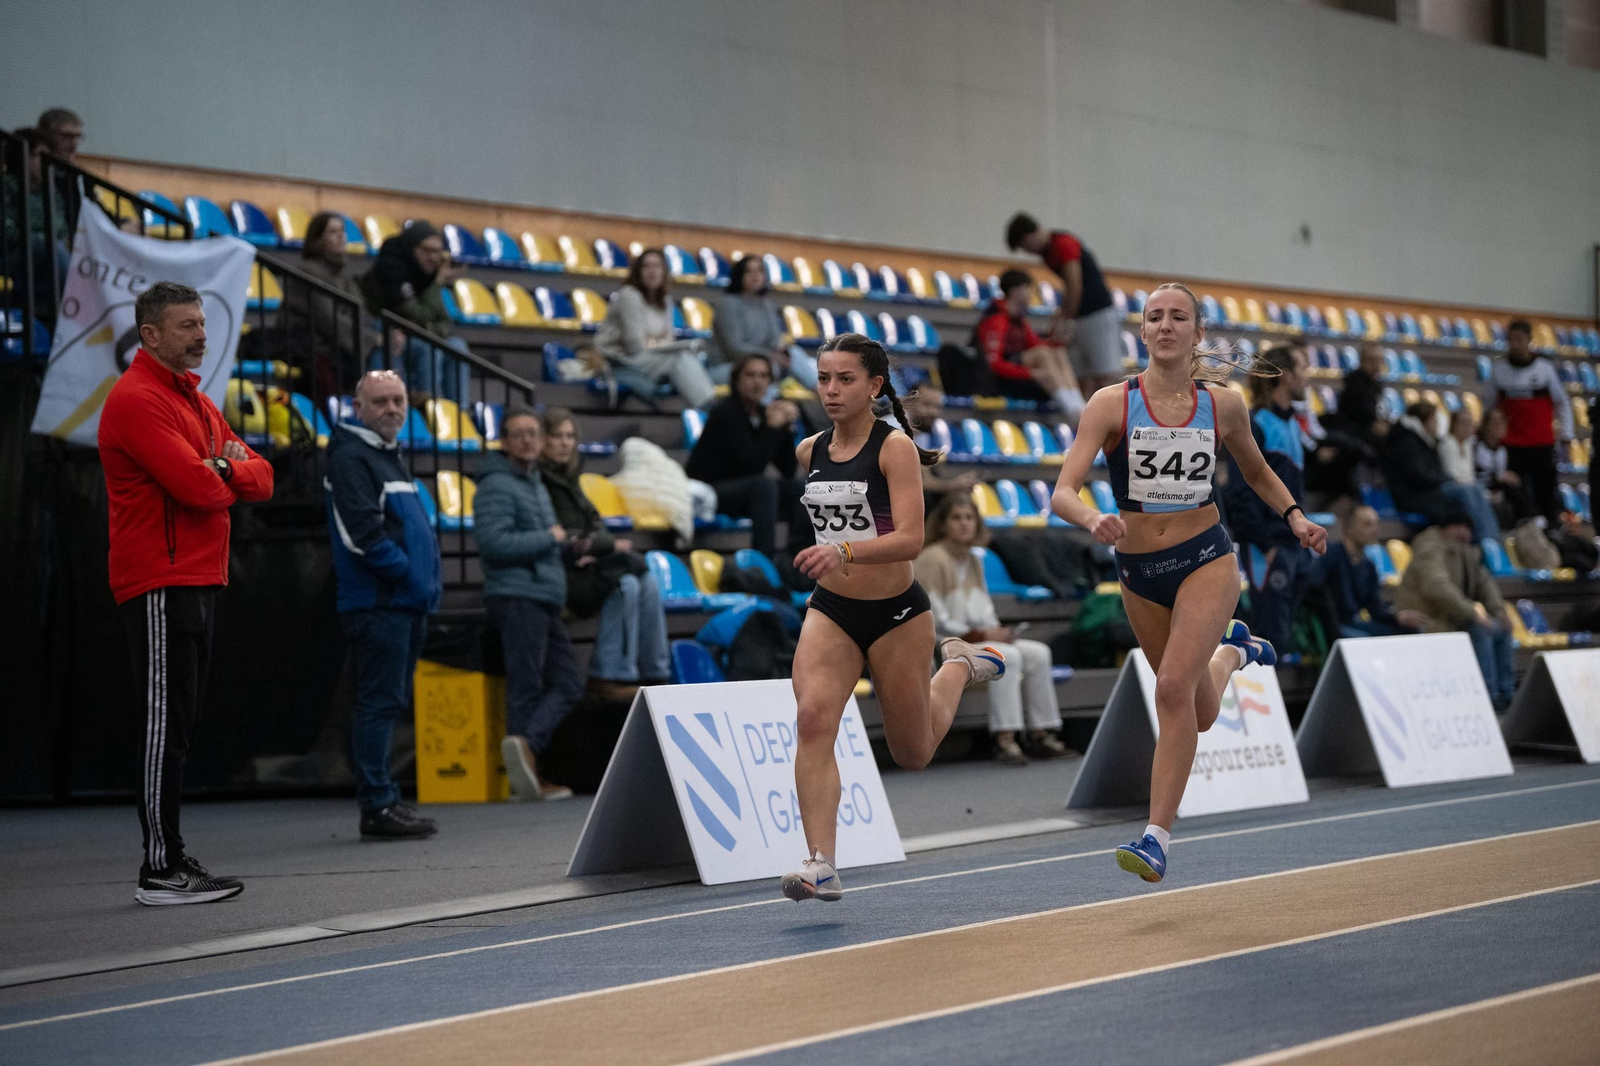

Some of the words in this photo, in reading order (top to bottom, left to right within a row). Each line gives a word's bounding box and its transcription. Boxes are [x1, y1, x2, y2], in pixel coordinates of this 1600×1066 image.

[1134, 449, 1211, 481] 342
[1146, 490, 1195, 501] atletismo.gal
[807, 503, 870, 532] 333
[1154, 558, 1178, 569] XUNTA
[1155, 567, 1165, 575] DE
[1165, 559, 1192, 572] GALICIA
[743, 716, 865, 766] DEPE
[767, 782, 873, 834] GAGO
